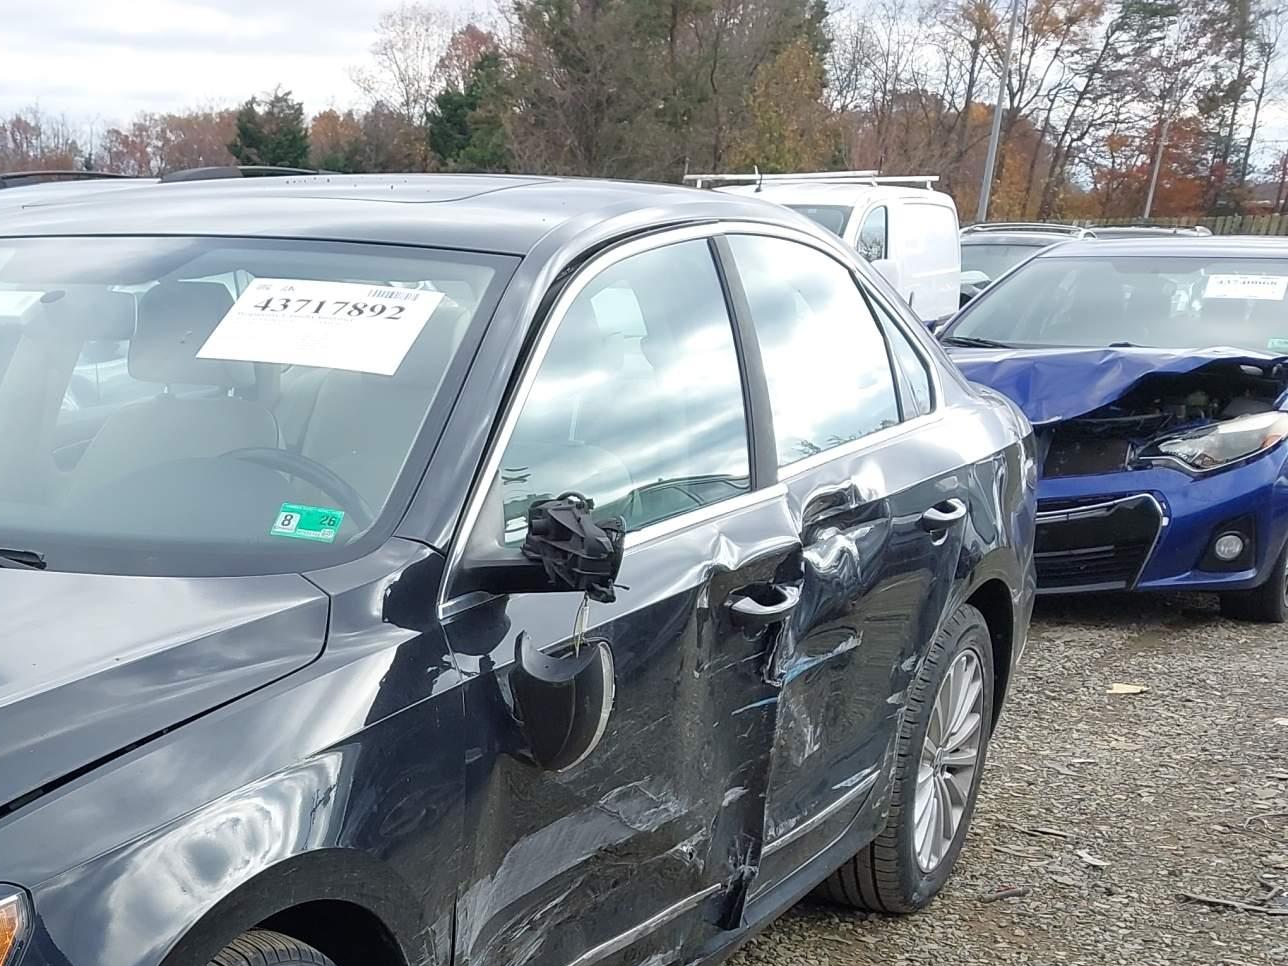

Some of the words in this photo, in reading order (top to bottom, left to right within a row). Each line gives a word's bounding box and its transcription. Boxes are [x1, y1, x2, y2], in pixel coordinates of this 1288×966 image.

[253, 297, 406, 320] 43717892
[281, 514, 294, 527] 8
[319, 515, 338, 527] 26
